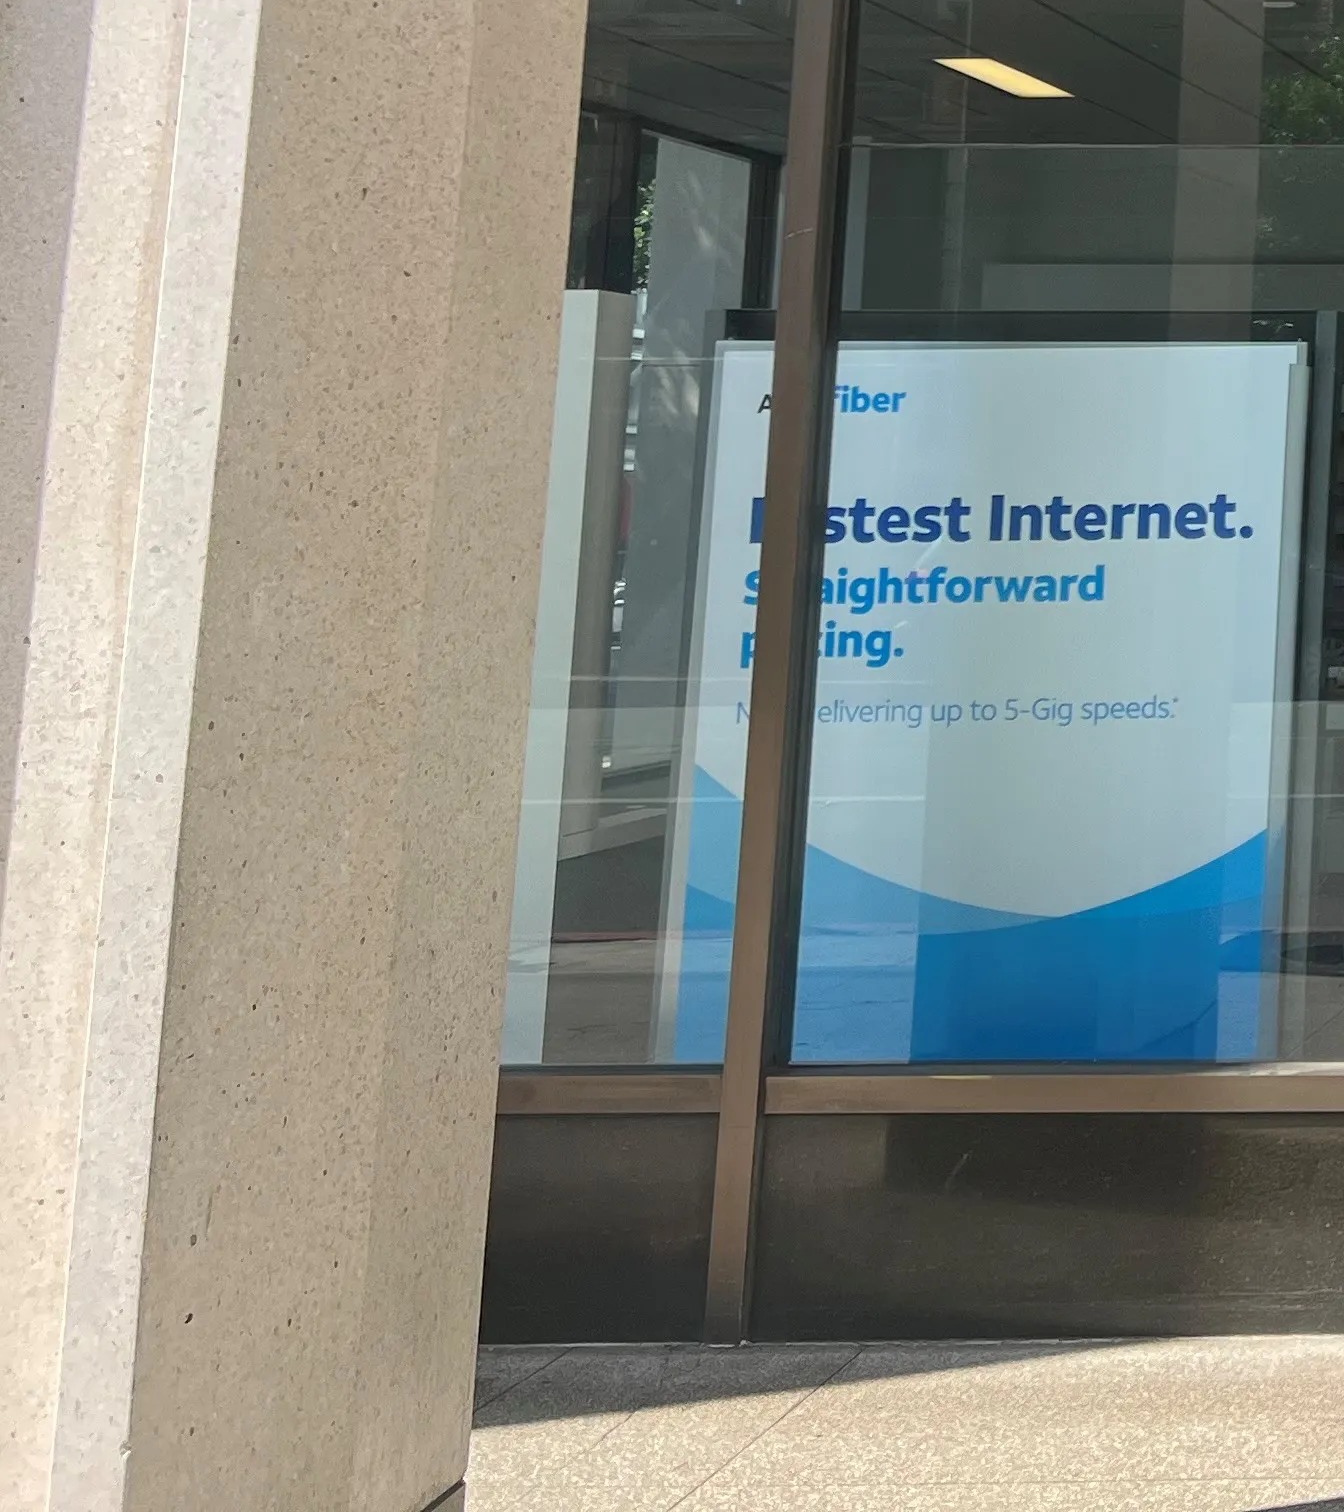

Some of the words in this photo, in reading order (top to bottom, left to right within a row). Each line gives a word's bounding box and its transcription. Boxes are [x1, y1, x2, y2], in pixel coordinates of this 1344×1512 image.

[750, 498, 971, 544] stest
[988, 493, 1255, 541] Internet.
[743, 564, 1106, 615] Sightforward
[739, 620, 904, 668] ping.
[817, 698, 923, 728] elivering
[930, 701, 963, 728] up
[969, 699, 998, 721] to
[1004, 697, 1074, 727] 5-Gig
